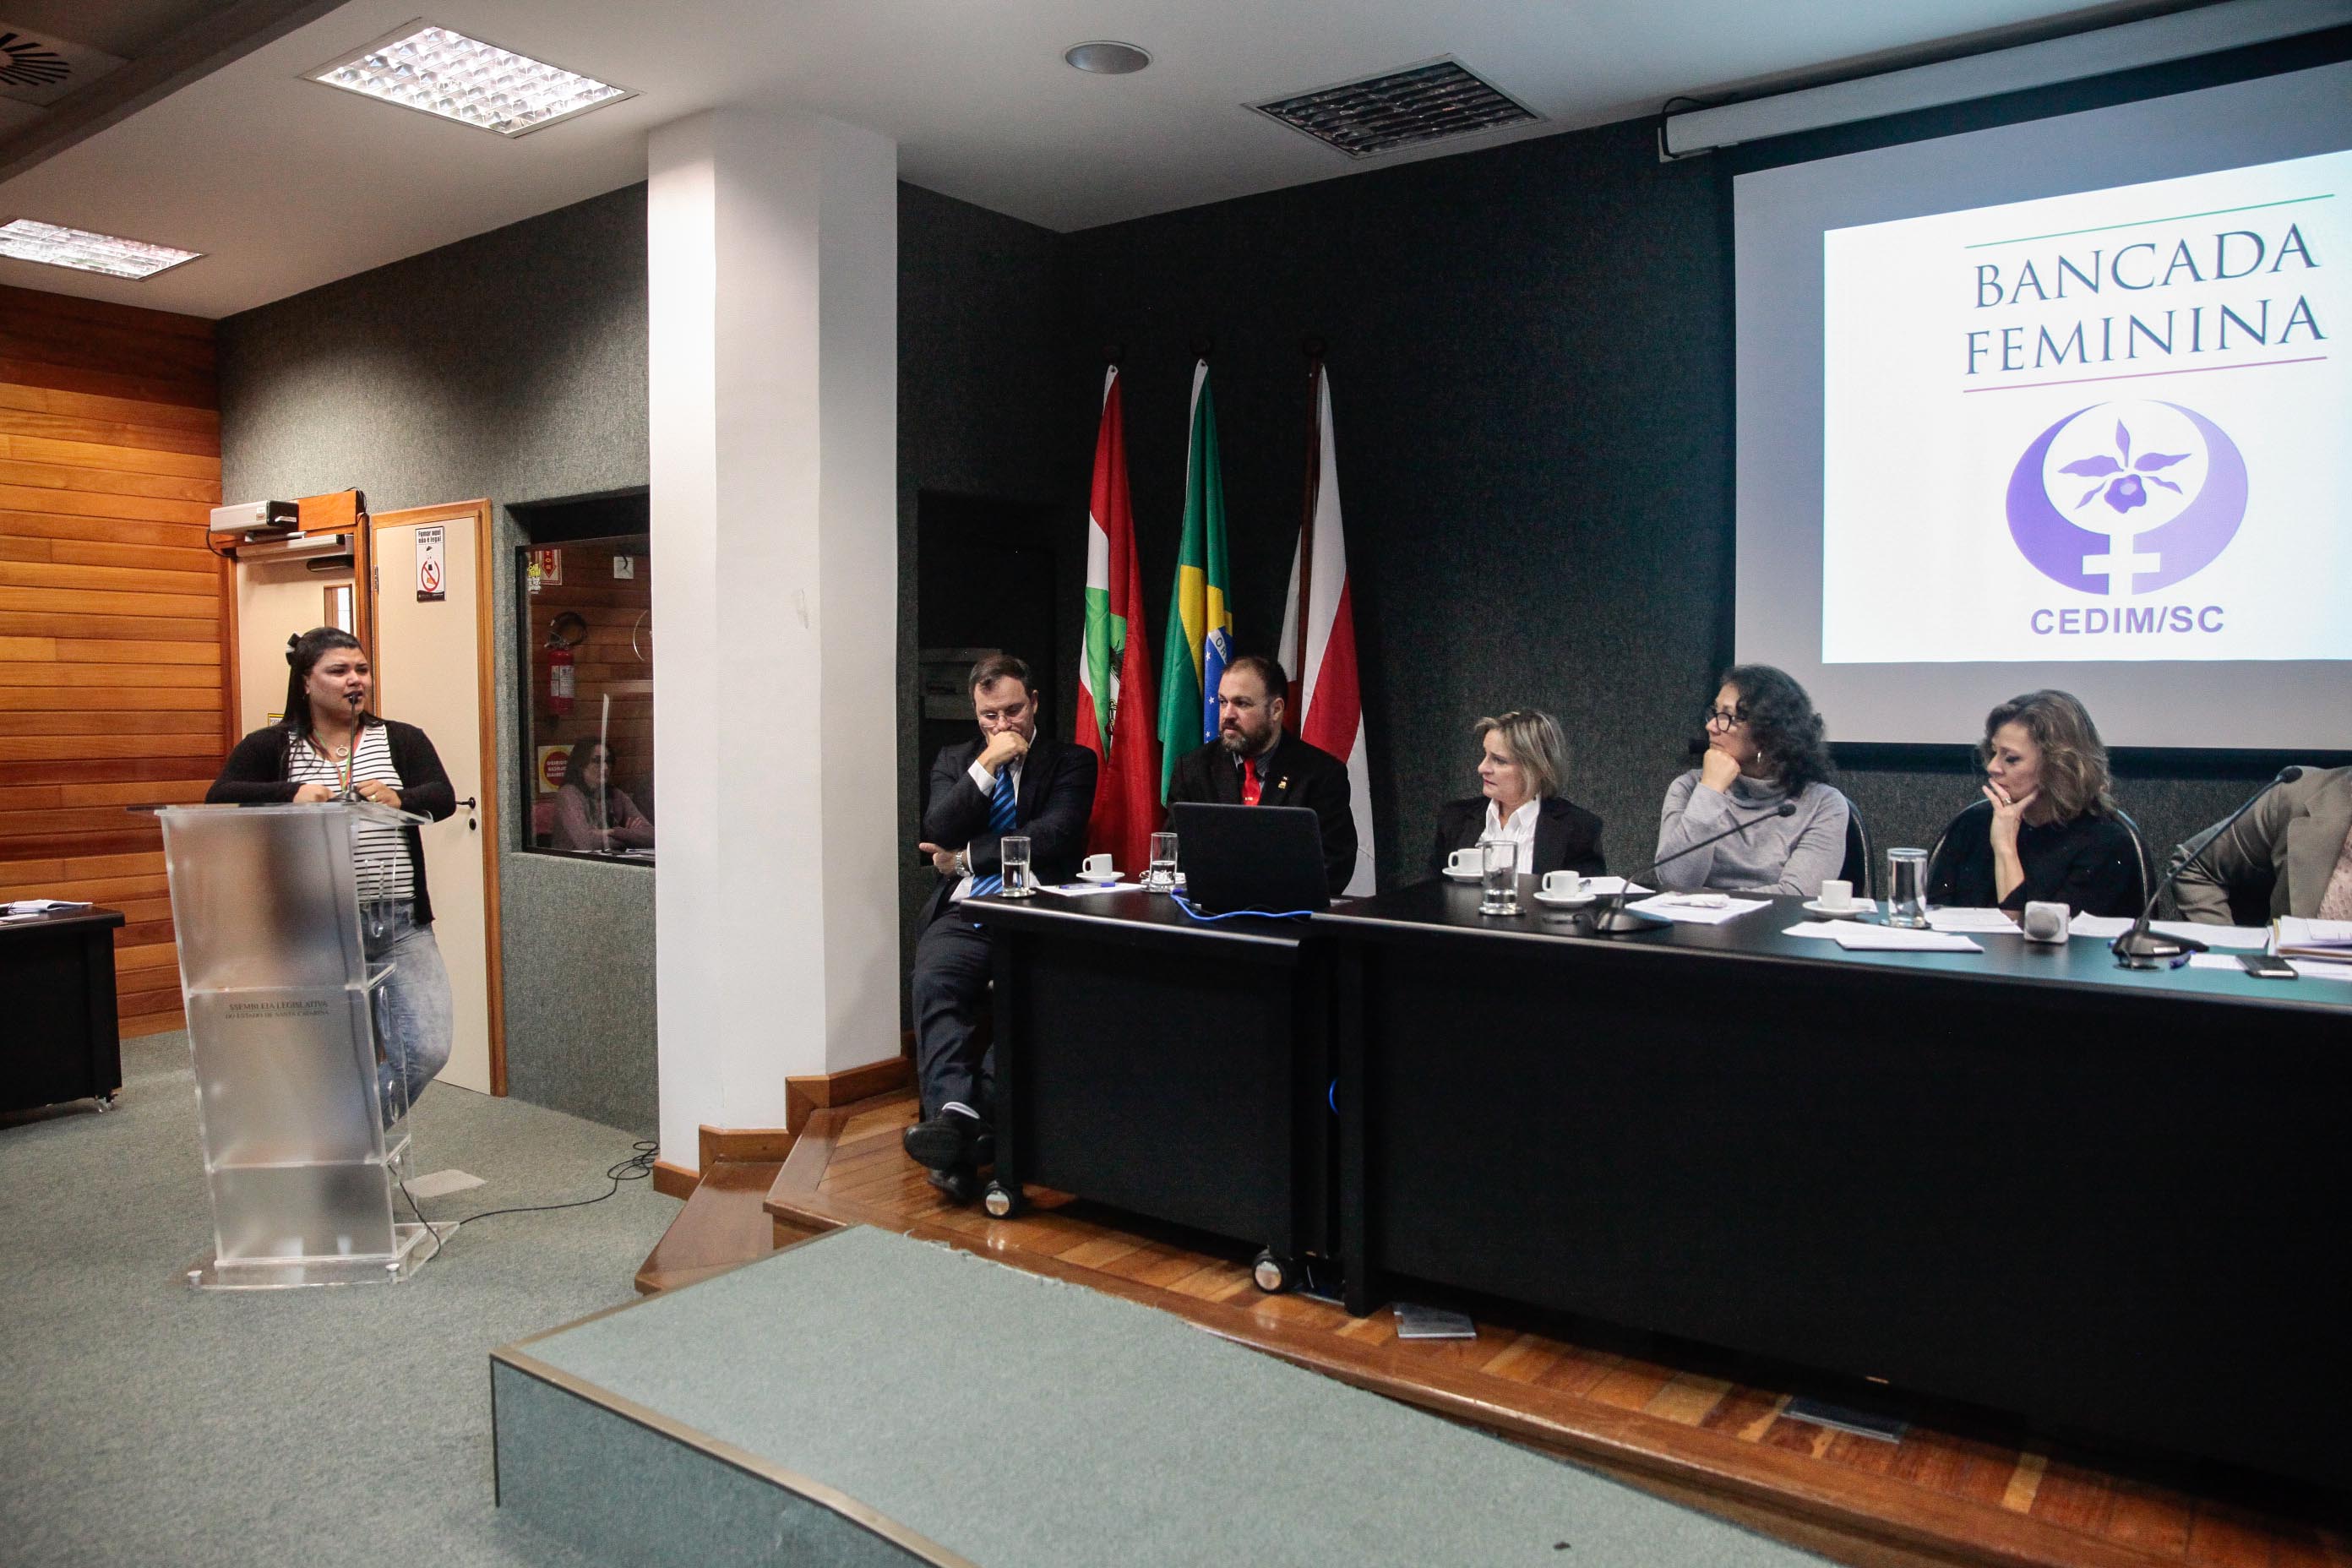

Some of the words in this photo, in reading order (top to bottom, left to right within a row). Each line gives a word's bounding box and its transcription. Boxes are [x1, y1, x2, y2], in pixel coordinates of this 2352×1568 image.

[1975, 222, 2322, 309] BANCADA
[1966, 294, 2329, 376] FEMININA
[2030, 605, 2224, 635] CEDIM/SC
[276, 1000, 328, 1010] LEGISLATIVA
